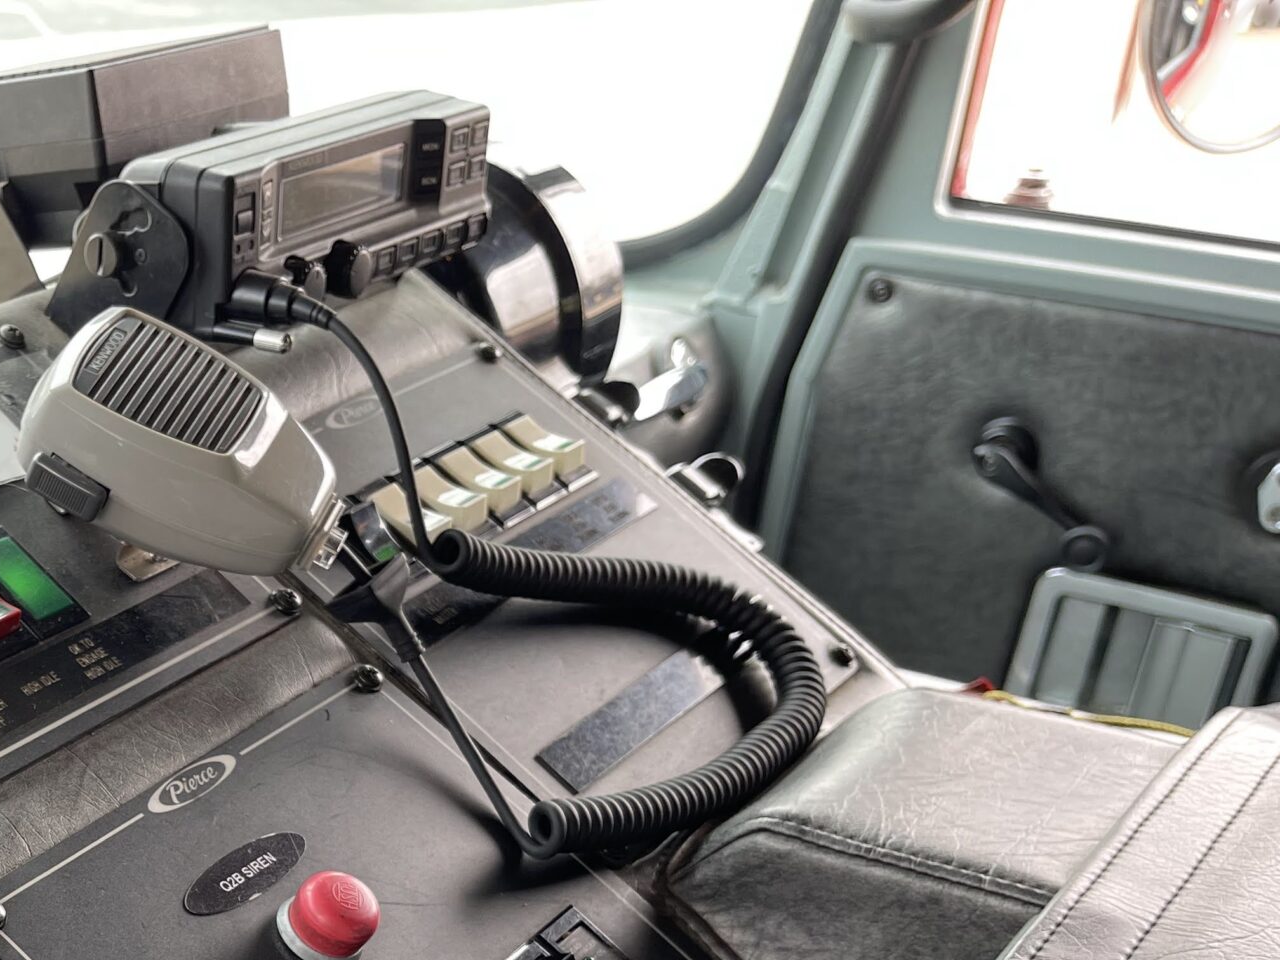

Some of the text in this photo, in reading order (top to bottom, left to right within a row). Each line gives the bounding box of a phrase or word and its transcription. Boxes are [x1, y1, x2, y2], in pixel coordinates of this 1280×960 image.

[89, 331, 125, 371] KENWOOD
[20, 671, 61, 697] HIGH IDLE
[165, 764, 219, 805] Pierce
[219, 851, 277, 893] Q2B SIREN
